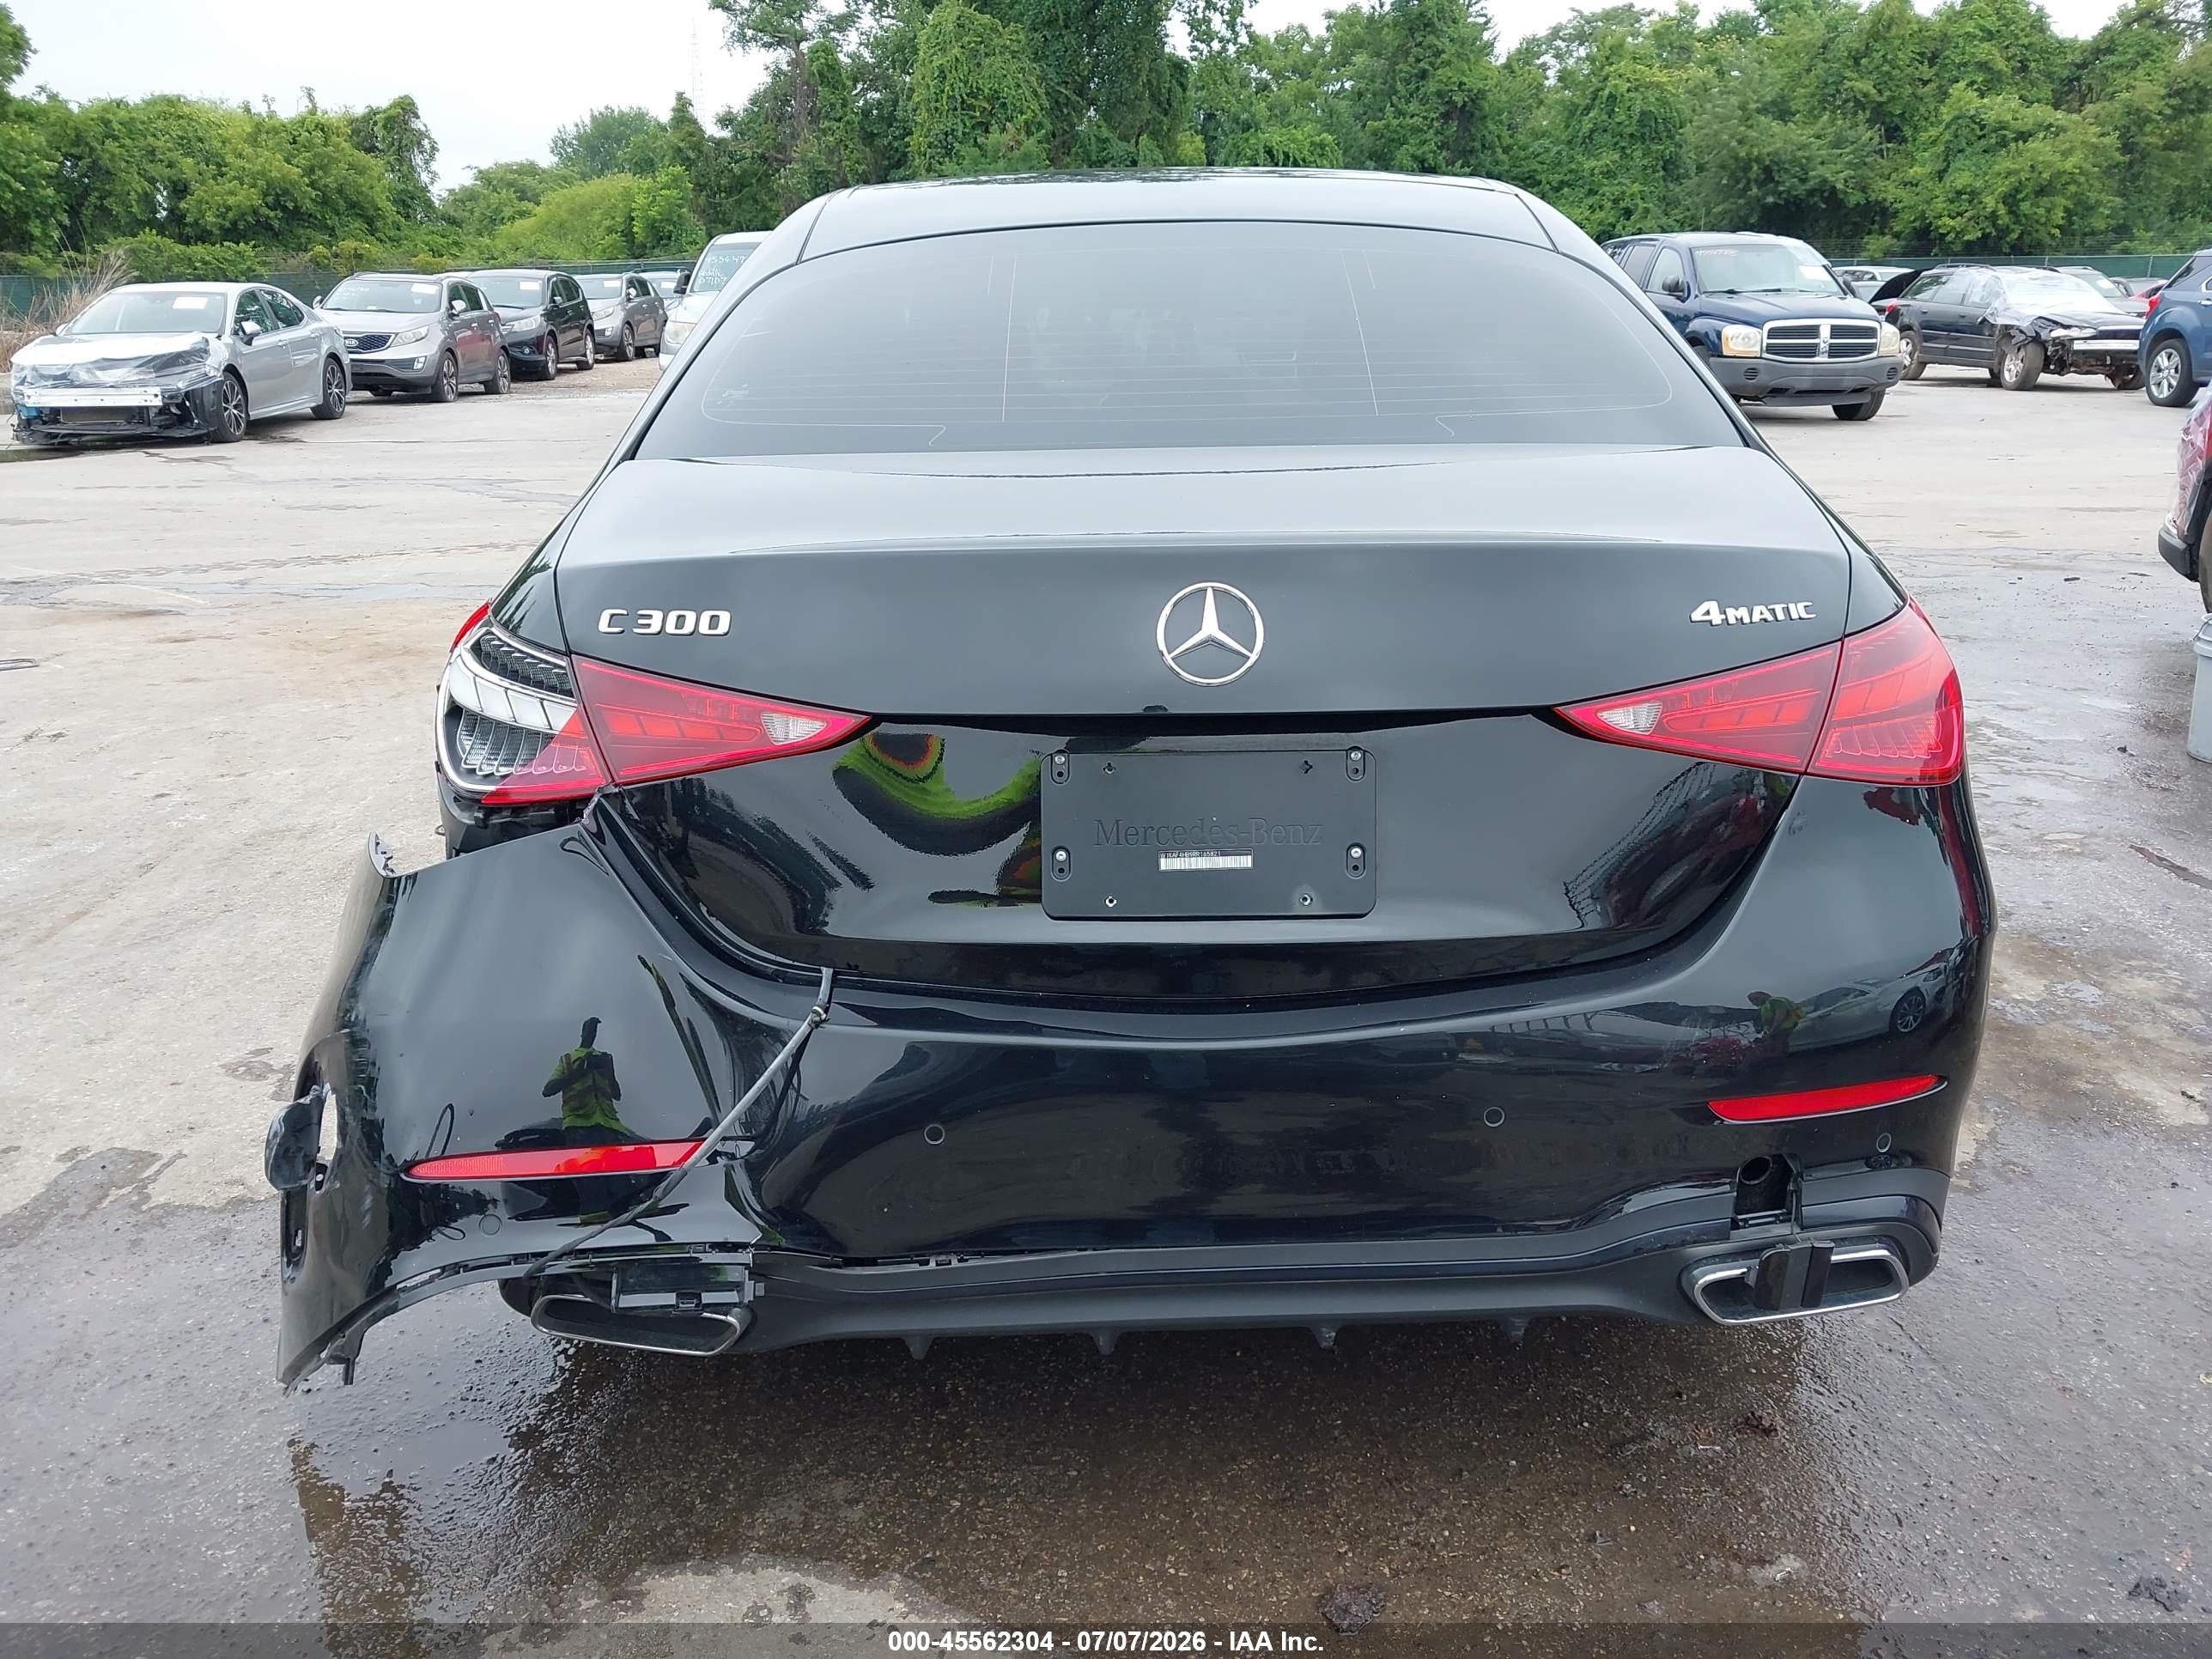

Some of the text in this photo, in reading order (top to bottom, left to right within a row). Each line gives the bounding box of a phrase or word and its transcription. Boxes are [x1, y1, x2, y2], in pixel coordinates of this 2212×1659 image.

[598, 608, 732, 636] C 300
[1691, 600, 1816, 626] 4MATIC
[1092, 817, 1324, 847] Mercedes-Benz
